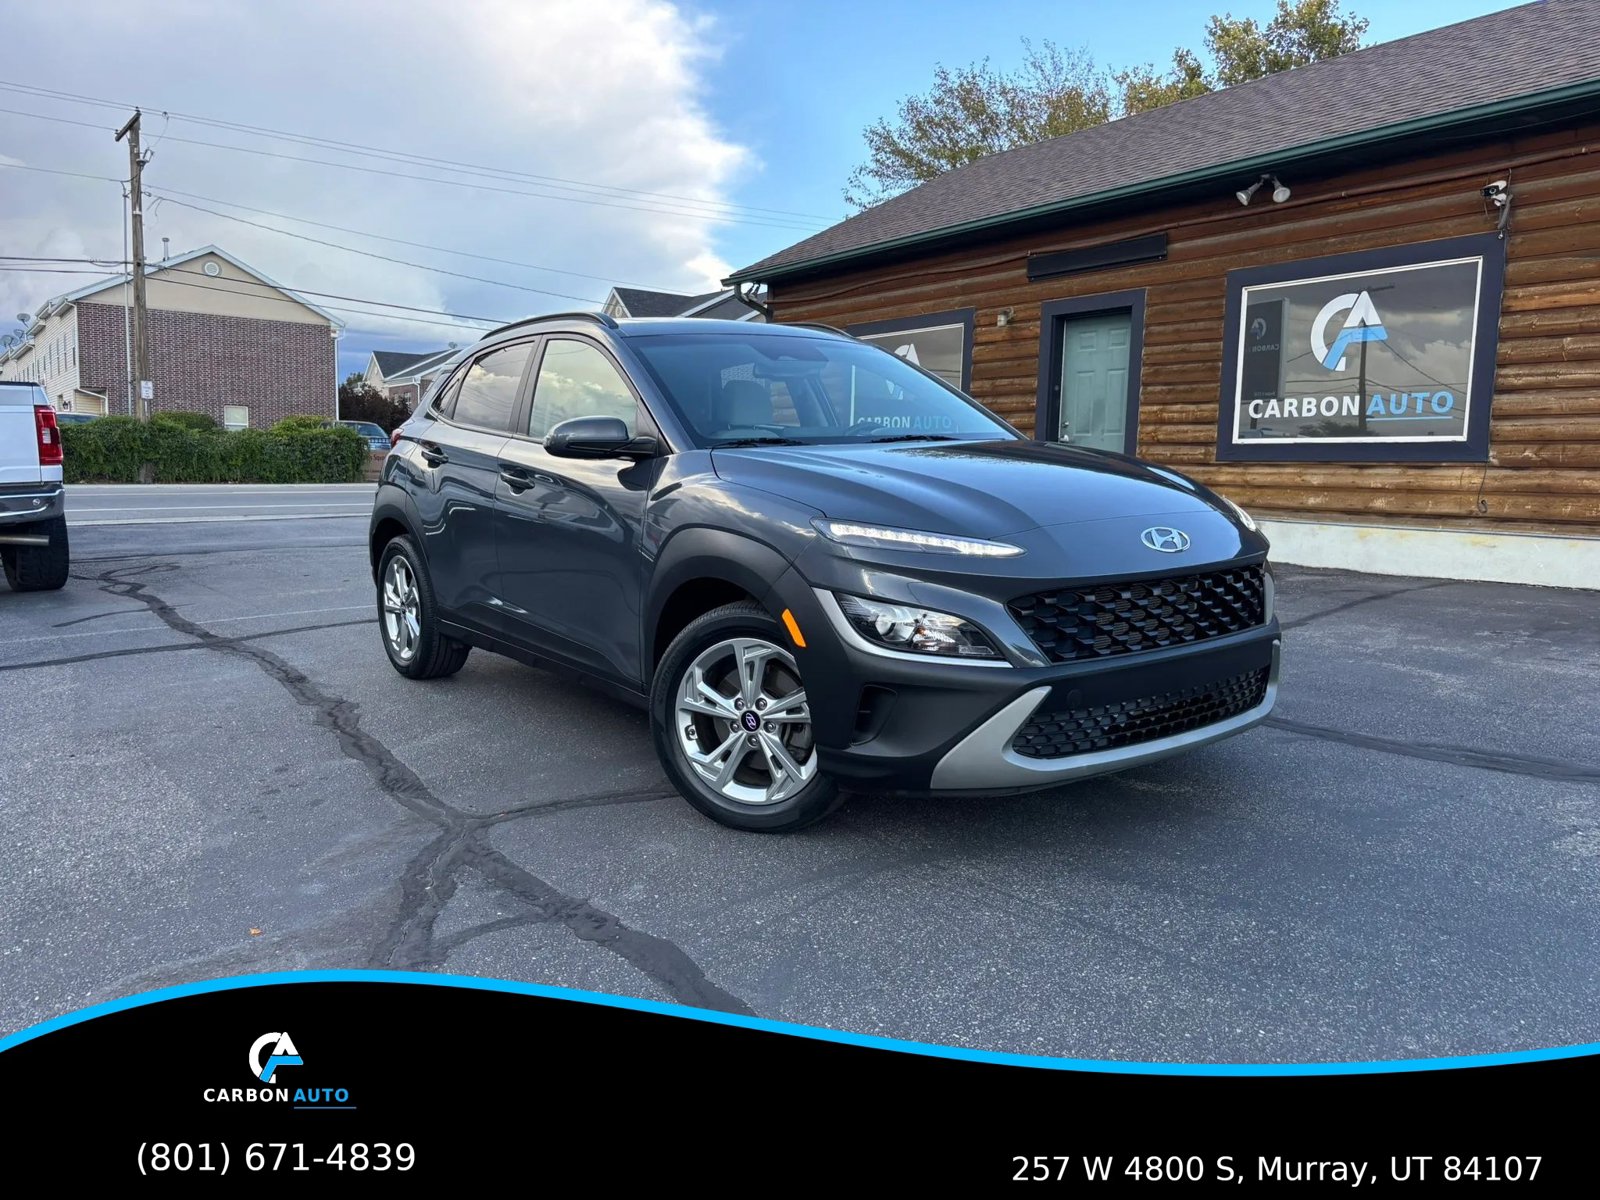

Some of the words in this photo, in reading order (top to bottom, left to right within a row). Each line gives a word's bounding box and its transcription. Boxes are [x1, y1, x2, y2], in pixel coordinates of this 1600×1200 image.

[1248, 395, 1360, 419] CARBON
[1366, 391, 1454, 416] AUTO
[914, 415, 952, 430] AUTO
